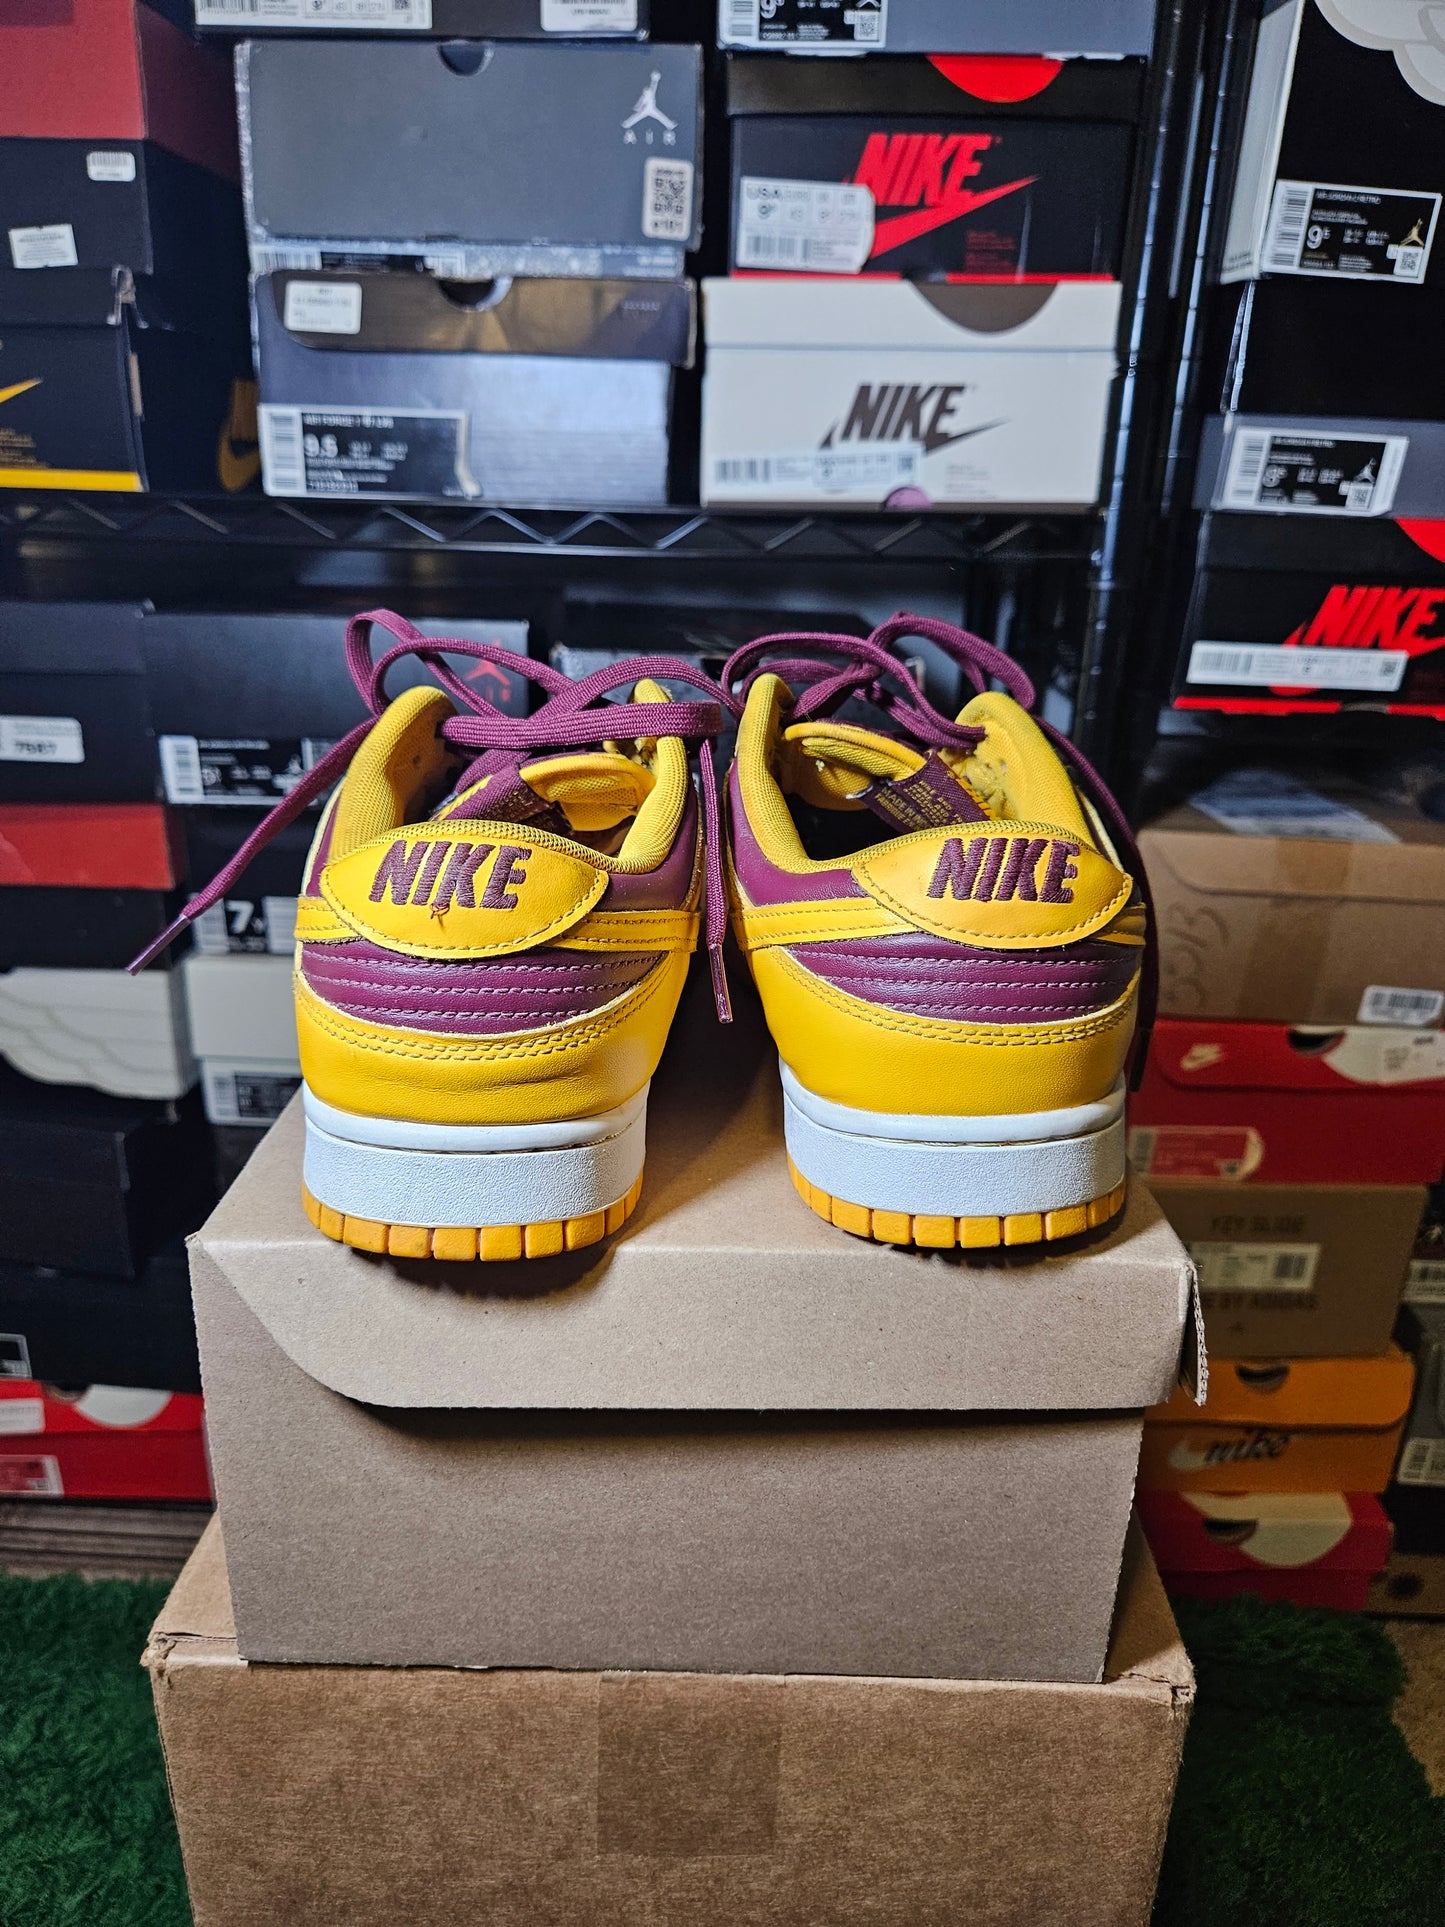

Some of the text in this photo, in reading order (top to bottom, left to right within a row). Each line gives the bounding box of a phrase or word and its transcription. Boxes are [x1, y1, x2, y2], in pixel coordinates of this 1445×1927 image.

[623, 129, 677, 146] AIR
[853, 132, 993, 207] NIKE
[840, 384, 966, 441] NIKE
[1302, 585, 1445, 651] NIKE
[880, 786, 907, 811] MADE
[904, 805, 916, 818] IN
[368, 839, 533, 910] NIKE
[927, 837, 1081, 904] NIKE
